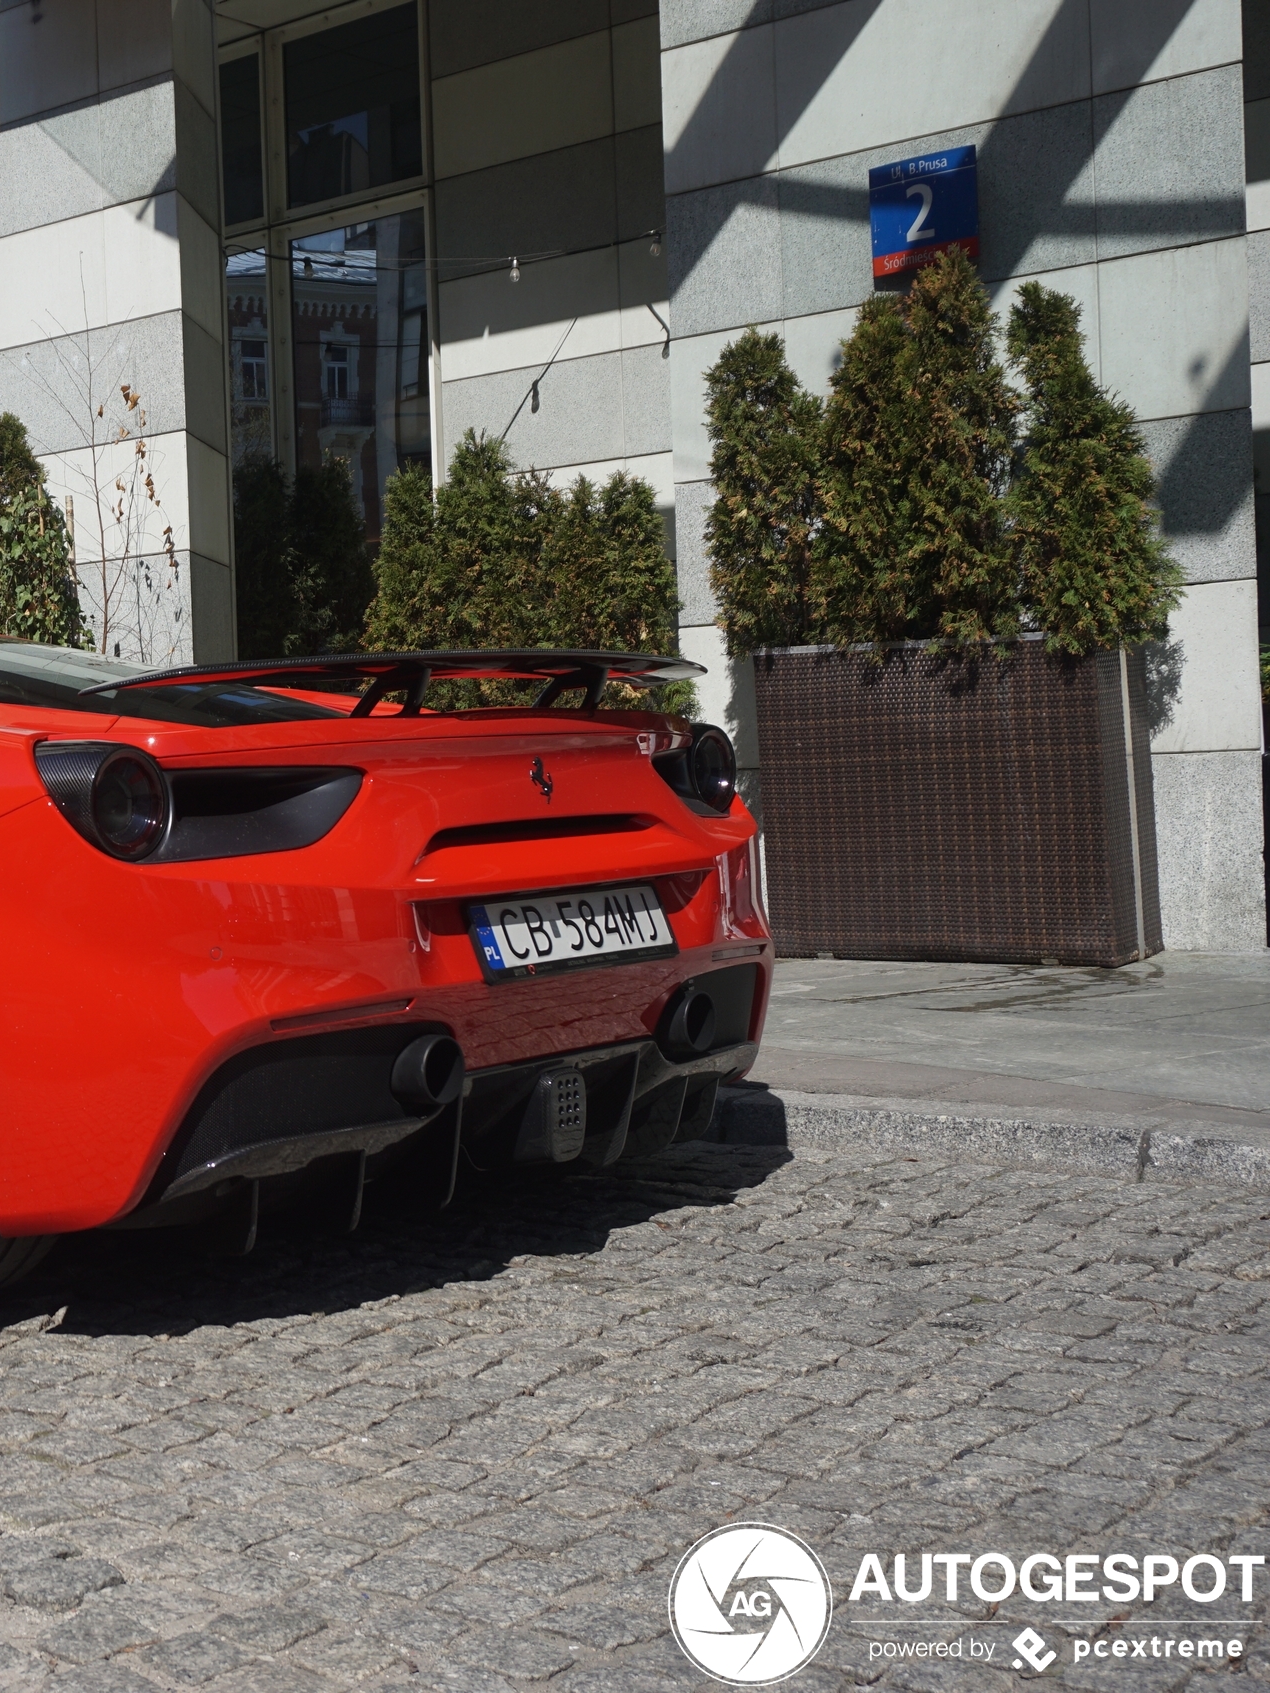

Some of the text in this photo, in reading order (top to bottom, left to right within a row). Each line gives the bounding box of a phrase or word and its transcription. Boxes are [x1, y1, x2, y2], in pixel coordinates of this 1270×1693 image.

[909, 158, 948, 175] B.Prusa
[905, 183, 936, 242] 2
[883, 247, 937, 270] Śródmieści
[499, 893, 658, 959] CB 584MJ
[484, 946, 501, 962] PL
